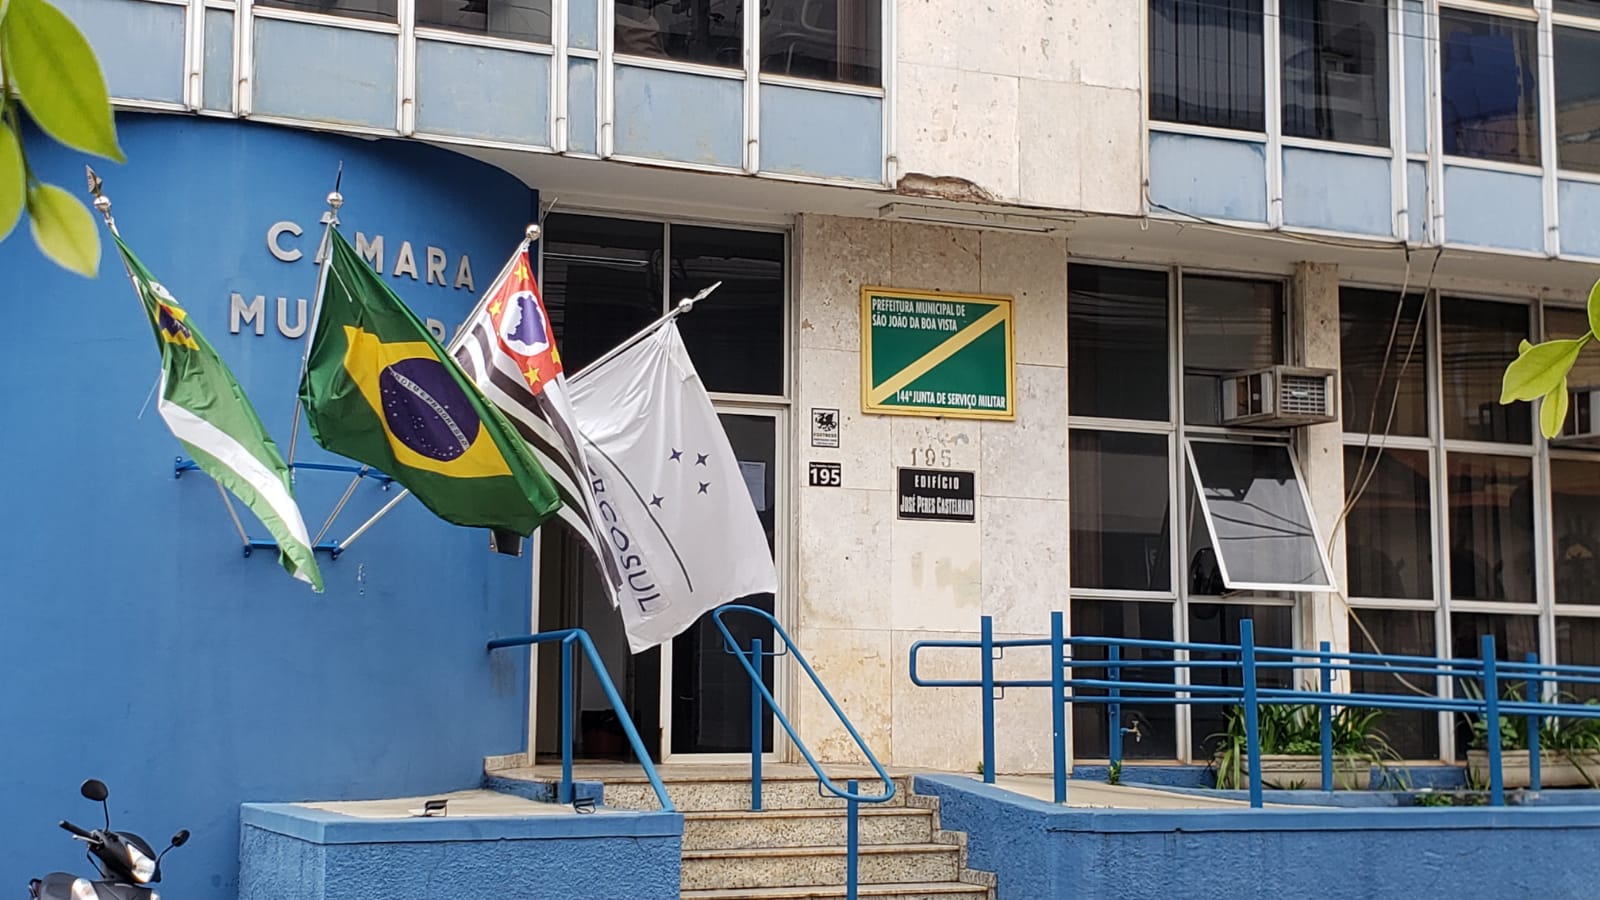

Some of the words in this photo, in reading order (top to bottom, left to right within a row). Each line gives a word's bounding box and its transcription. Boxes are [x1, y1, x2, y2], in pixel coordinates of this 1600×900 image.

[872, 298, 914, 313] PREFEITURA
[916, 302, 955, 316] MUNICIPAL
[956, 304, 965, 317] DE
[872, 311, 887, 327] SÃO
[888, 312, 908, 328] JOÃO
[909, 316, 920, 329] DA
[921, 317, 937, 330] BOA
[937, 318, 957, 331] VISTA
[913, 390, 935, 404] JUNTA
[936, 392, 946, 404] DE
[947, 393, 977, 409] SERVIÇO
[978, 394, 1006, 408] MILITAR
[911, 447, 951, 467] 195
[810, 468, 840, 485] 195
[914, 474, 959, 490] EDIFÍCIO
[900, 494, 916, 513] JOSÉ
[917, 495, 935, 514] PERES
[588, 464, 661, 612] RCOSUL
